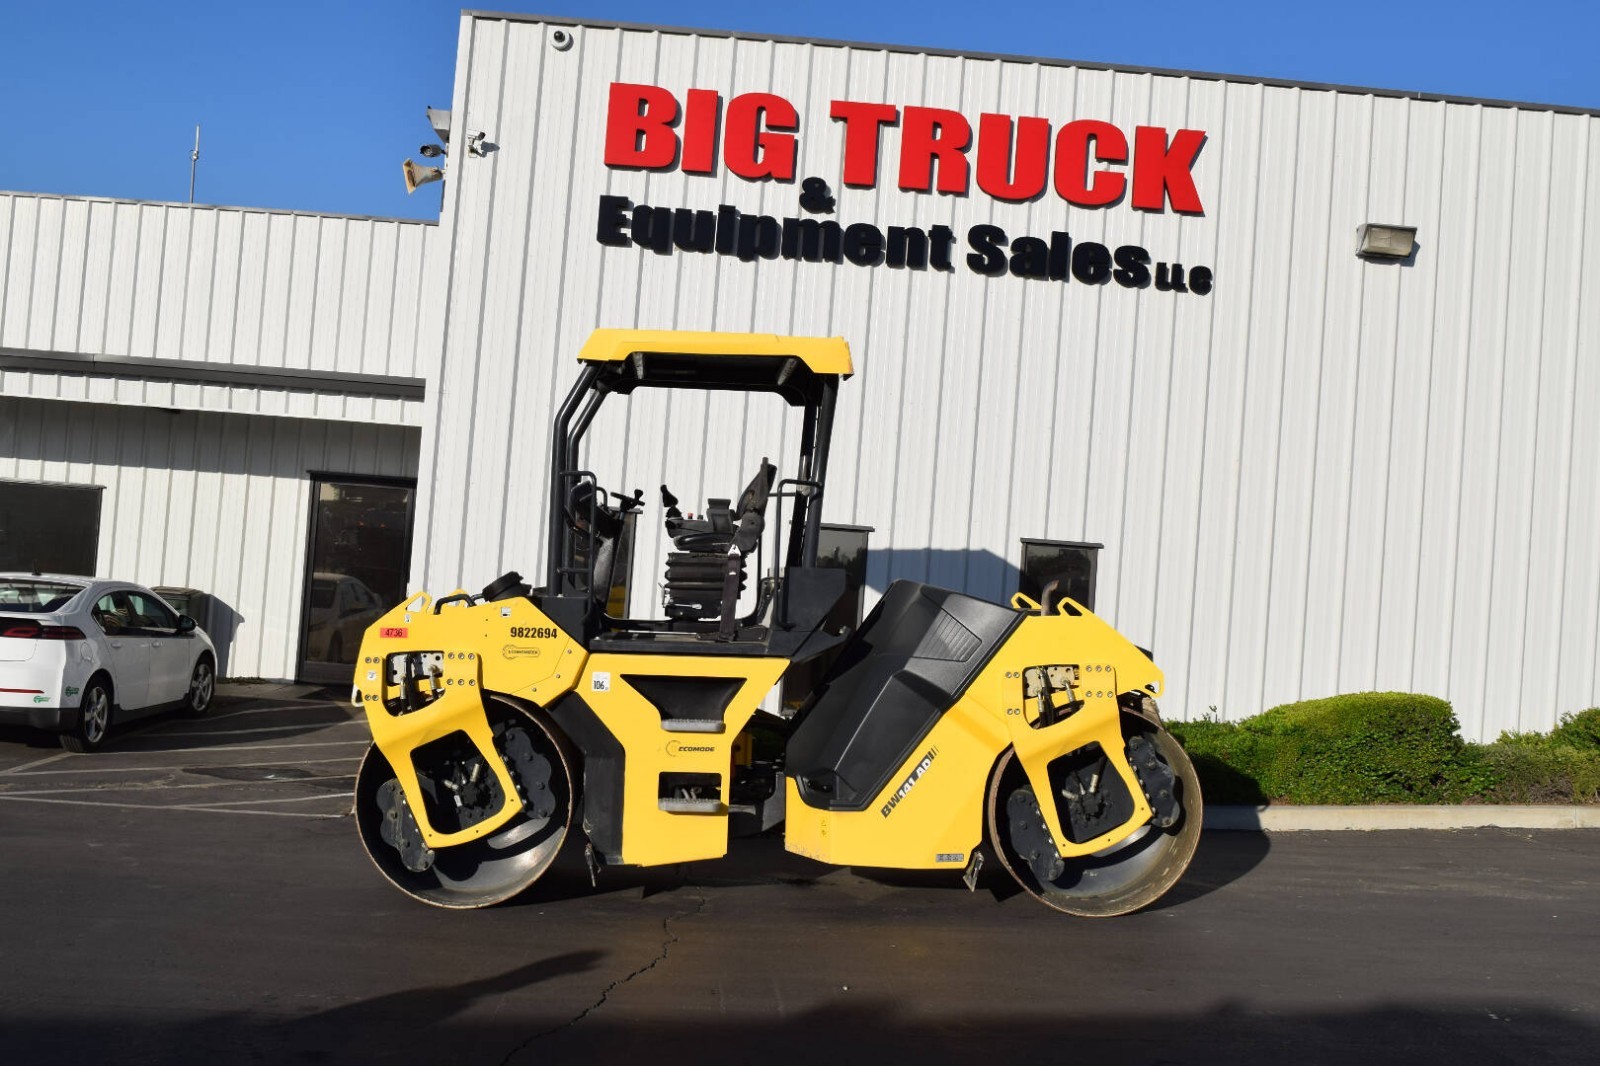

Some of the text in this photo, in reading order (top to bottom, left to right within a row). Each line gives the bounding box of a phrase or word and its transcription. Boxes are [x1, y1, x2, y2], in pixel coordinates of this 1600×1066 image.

[604, 82, 1206, 215] BIG TRUCK
[799, 177, 836, 215] &
[597, 195, 955, 272] Equipment
[966, 224, 1152, 288] Sales
[384, 628, 403, 637] 4736
[510, 626, 558, 639] 9822694
